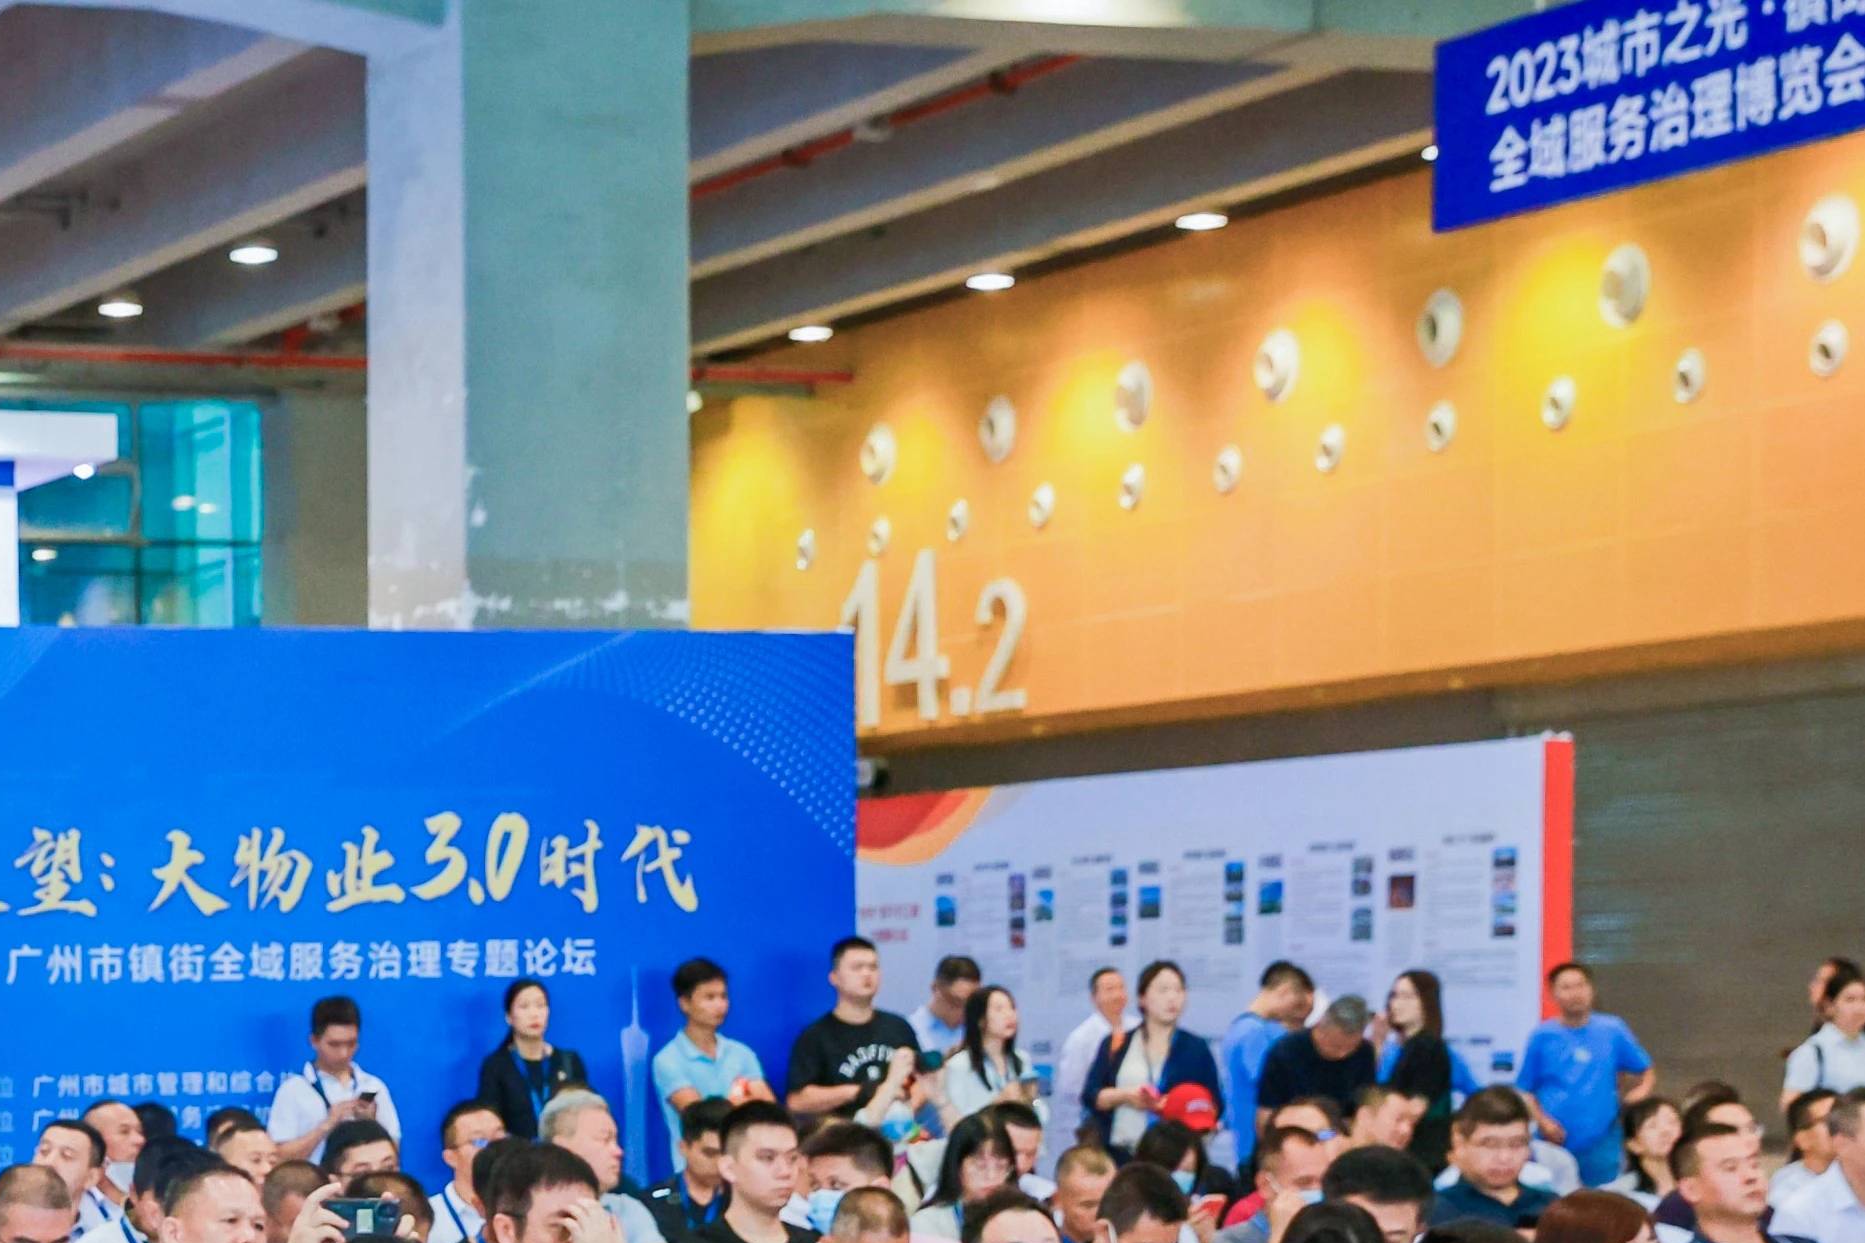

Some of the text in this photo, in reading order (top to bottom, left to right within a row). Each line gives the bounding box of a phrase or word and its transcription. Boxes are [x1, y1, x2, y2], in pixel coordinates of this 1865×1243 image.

[1489, 33, 1865, 193] 全域服务治理博览会
[839, 548, 1027, 728] 14.2
